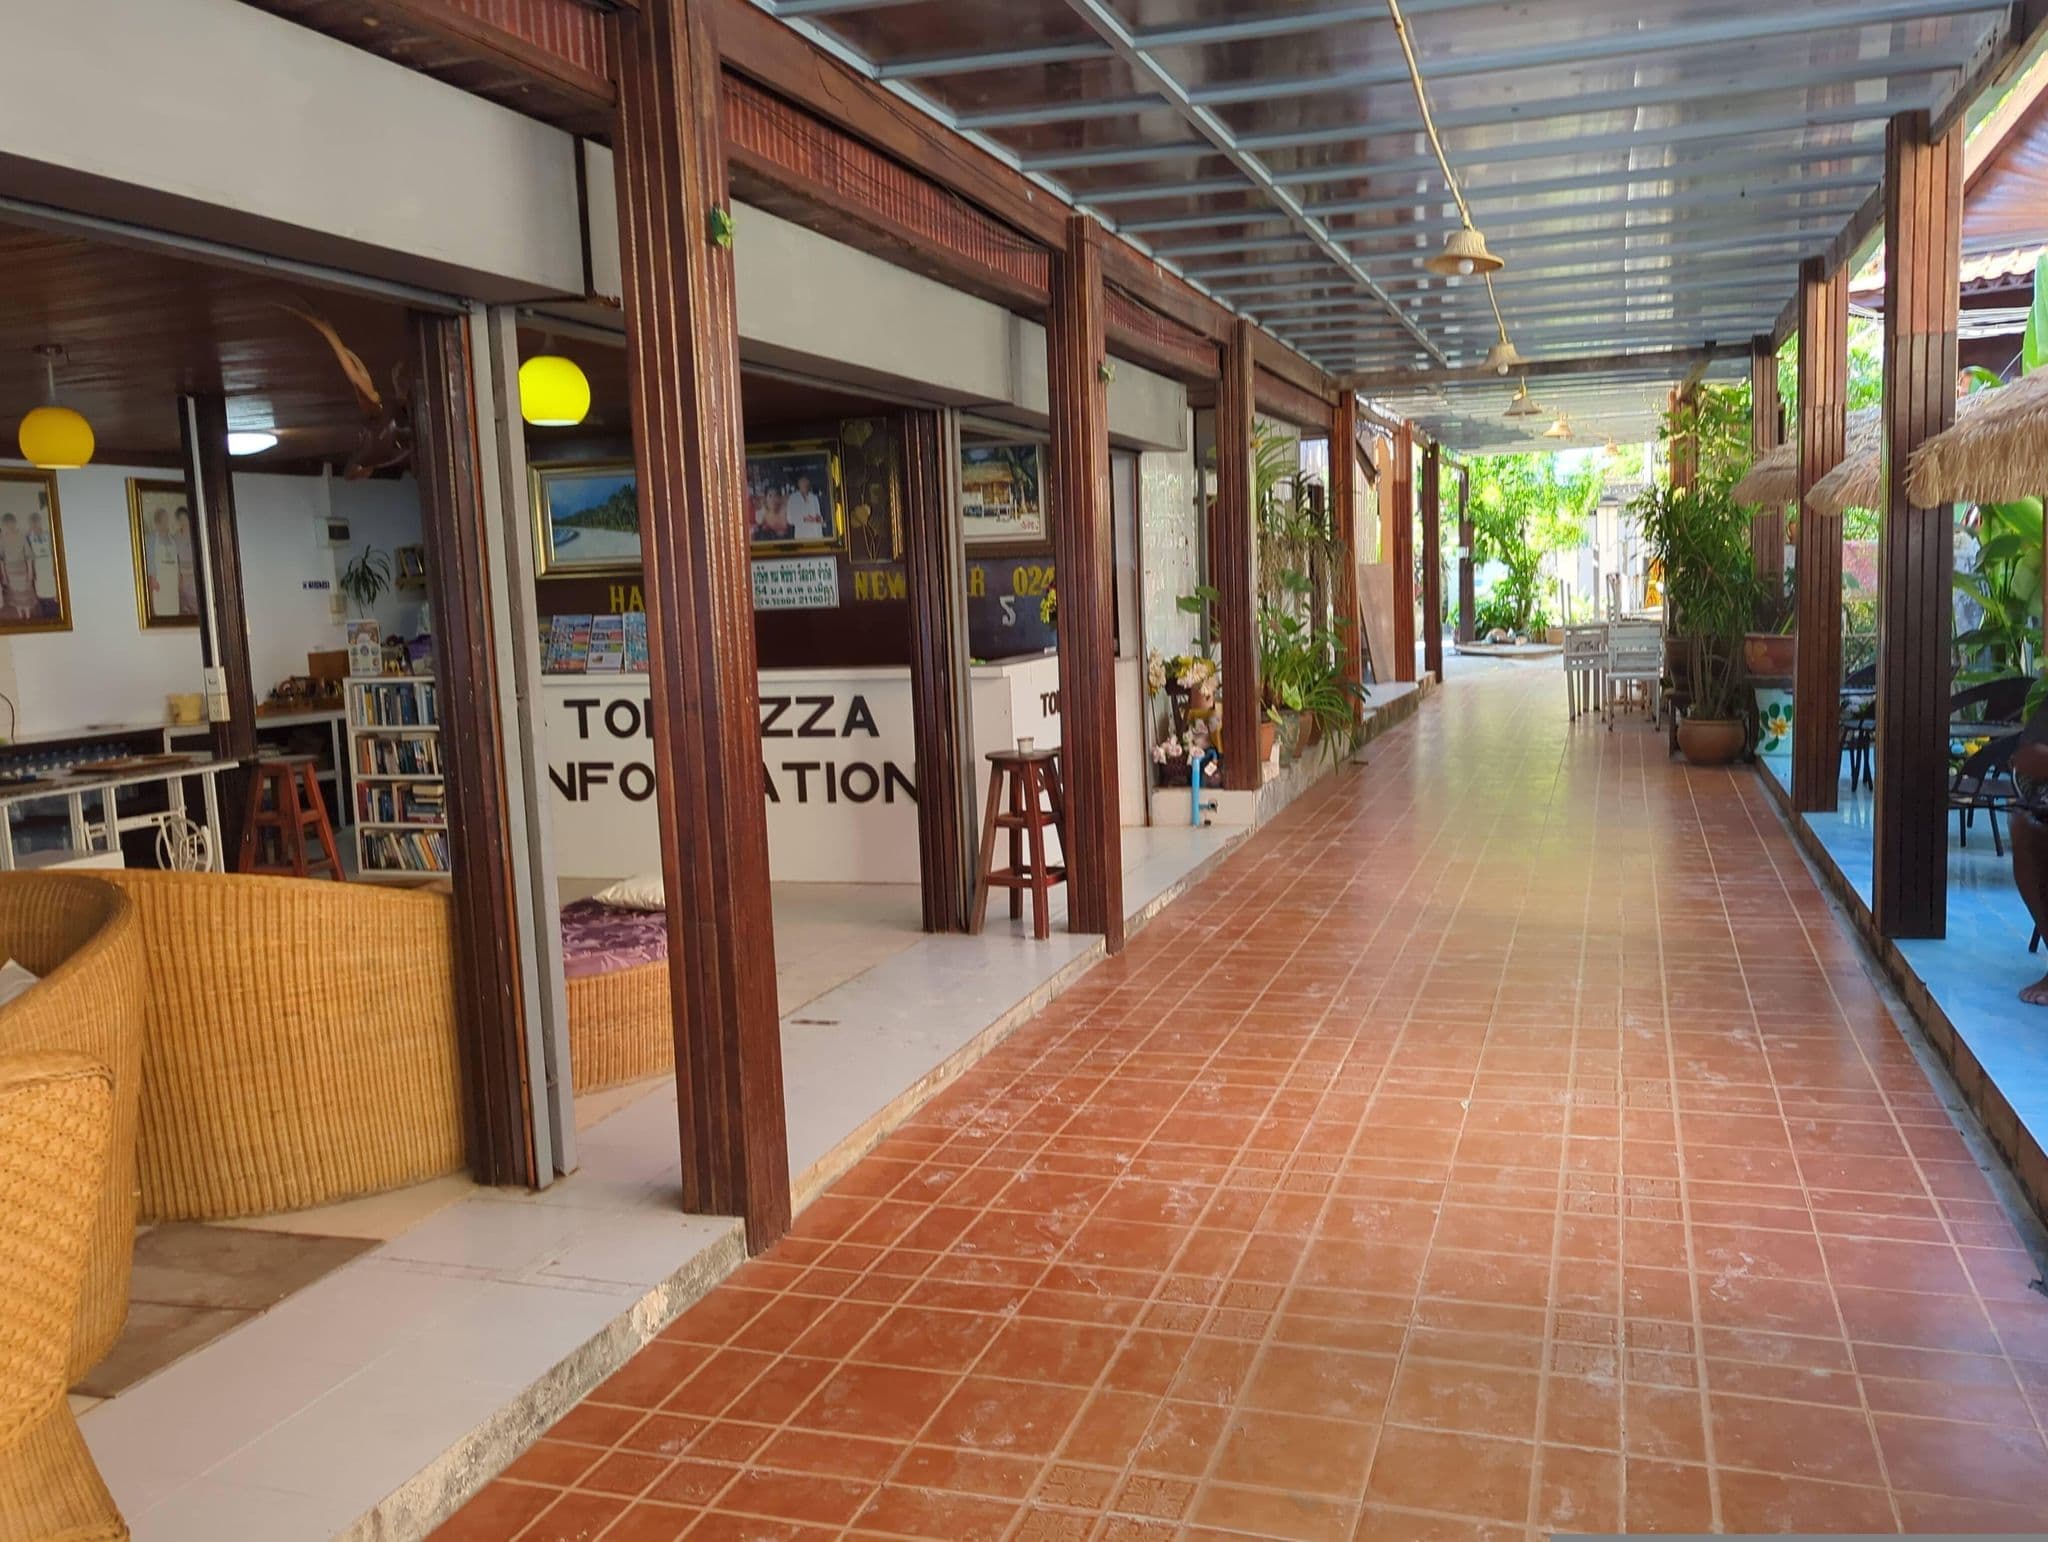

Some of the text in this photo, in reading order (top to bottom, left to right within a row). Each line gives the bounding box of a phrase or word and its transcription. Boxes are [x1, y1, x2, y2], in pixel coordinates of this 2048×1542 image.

[563, 695, 880, 739] TO ZZA
[1040, 690, 1061, 717] TO
